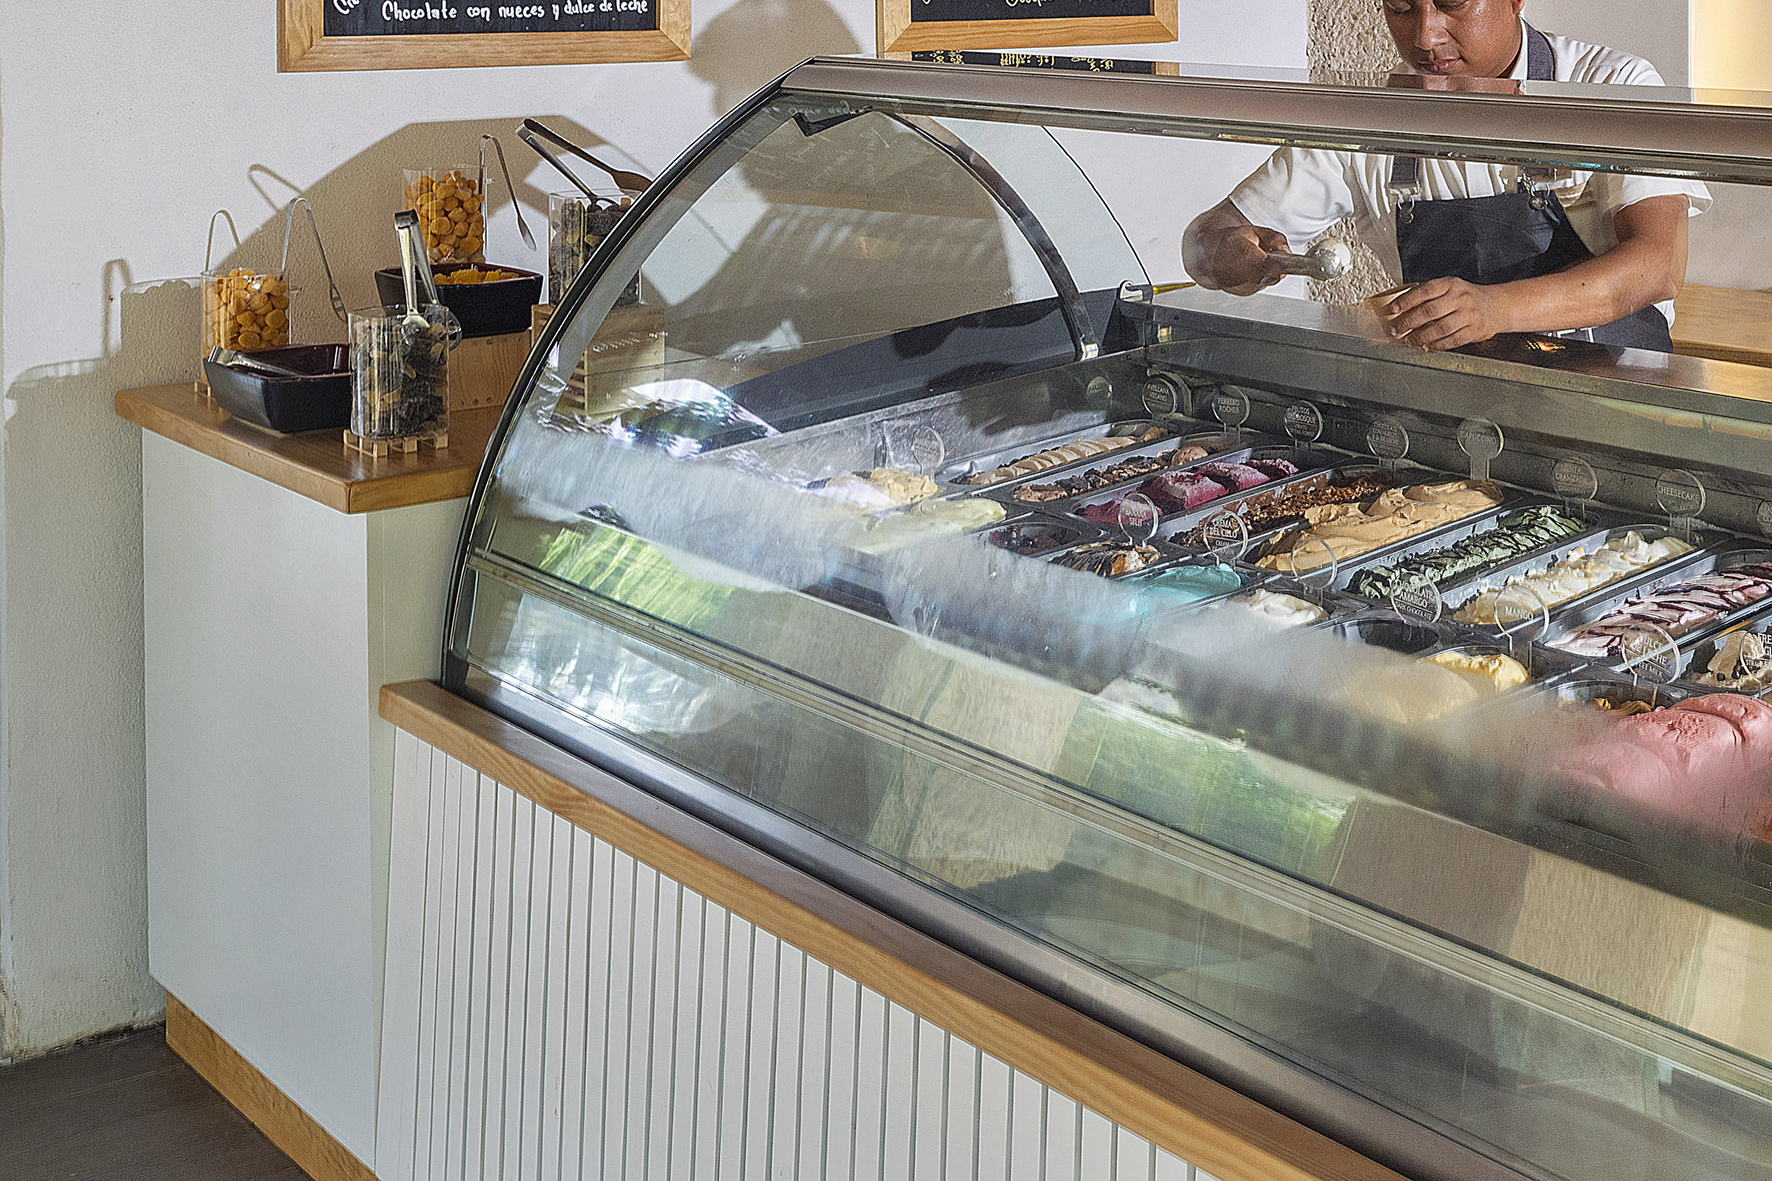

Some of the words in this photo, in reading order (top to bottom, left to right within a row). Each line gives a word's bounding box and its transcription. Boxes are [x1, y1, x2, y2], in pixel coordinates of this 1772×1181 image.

[382, 0, 457, 21] Chocolate
[467, 5, 490, 21] con
[498, 3, 545, 19] nueces
[551, 3, 560, 20] y
[564, 0, 595, 15] dulce
[1657, 485, 1700, 501] CHEESECAKE
[1399, 591, 1428, 608] AMARGO
[1505, 606, 1533, 620] MANGO
